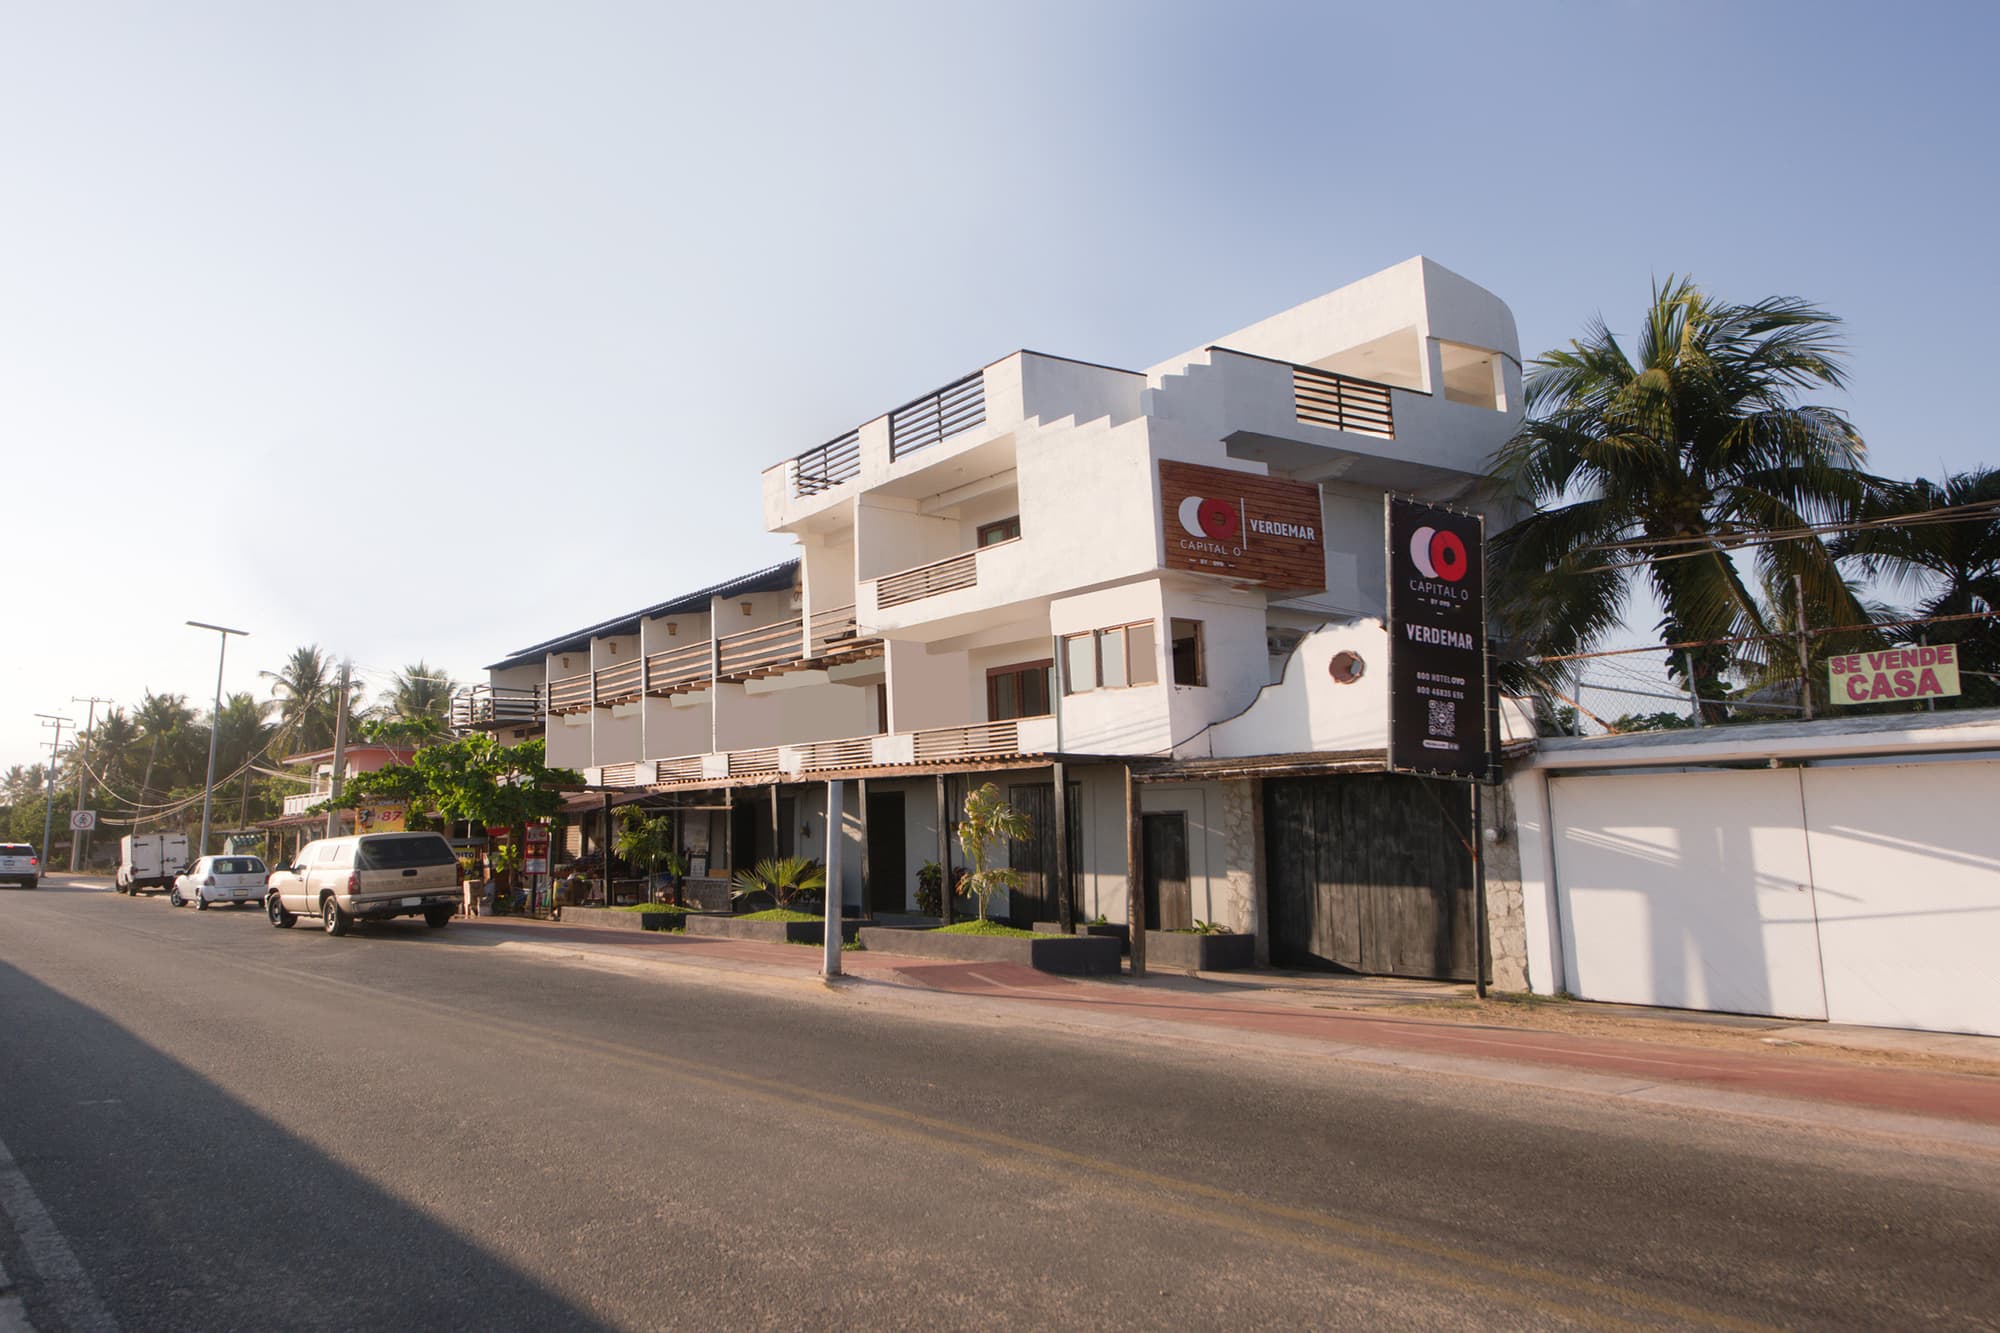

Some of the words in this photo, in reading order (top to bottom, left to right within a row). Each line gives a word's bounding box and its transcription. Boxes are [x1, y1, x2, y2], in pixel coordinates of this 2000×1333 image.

[1250, 519, 1315, 541] VERDEMAR
[1179, 539, 1229, 555] CAPITAL
[1232, 546, 1241, 557] O
[1409, 579, 1458, 599] CAPITAL
[1460, 588, 1469, 601] O
[1406, 623, 1474, 651] VERDEMAR
[1831, 654, 1862, 675] SE
[1866, 644, 1955, 671] VENDE
[1416, 671, 1430, 681] 800
[1846, 667, 1944, 702] CASA
[1416, 685, 1430, 695] 800
